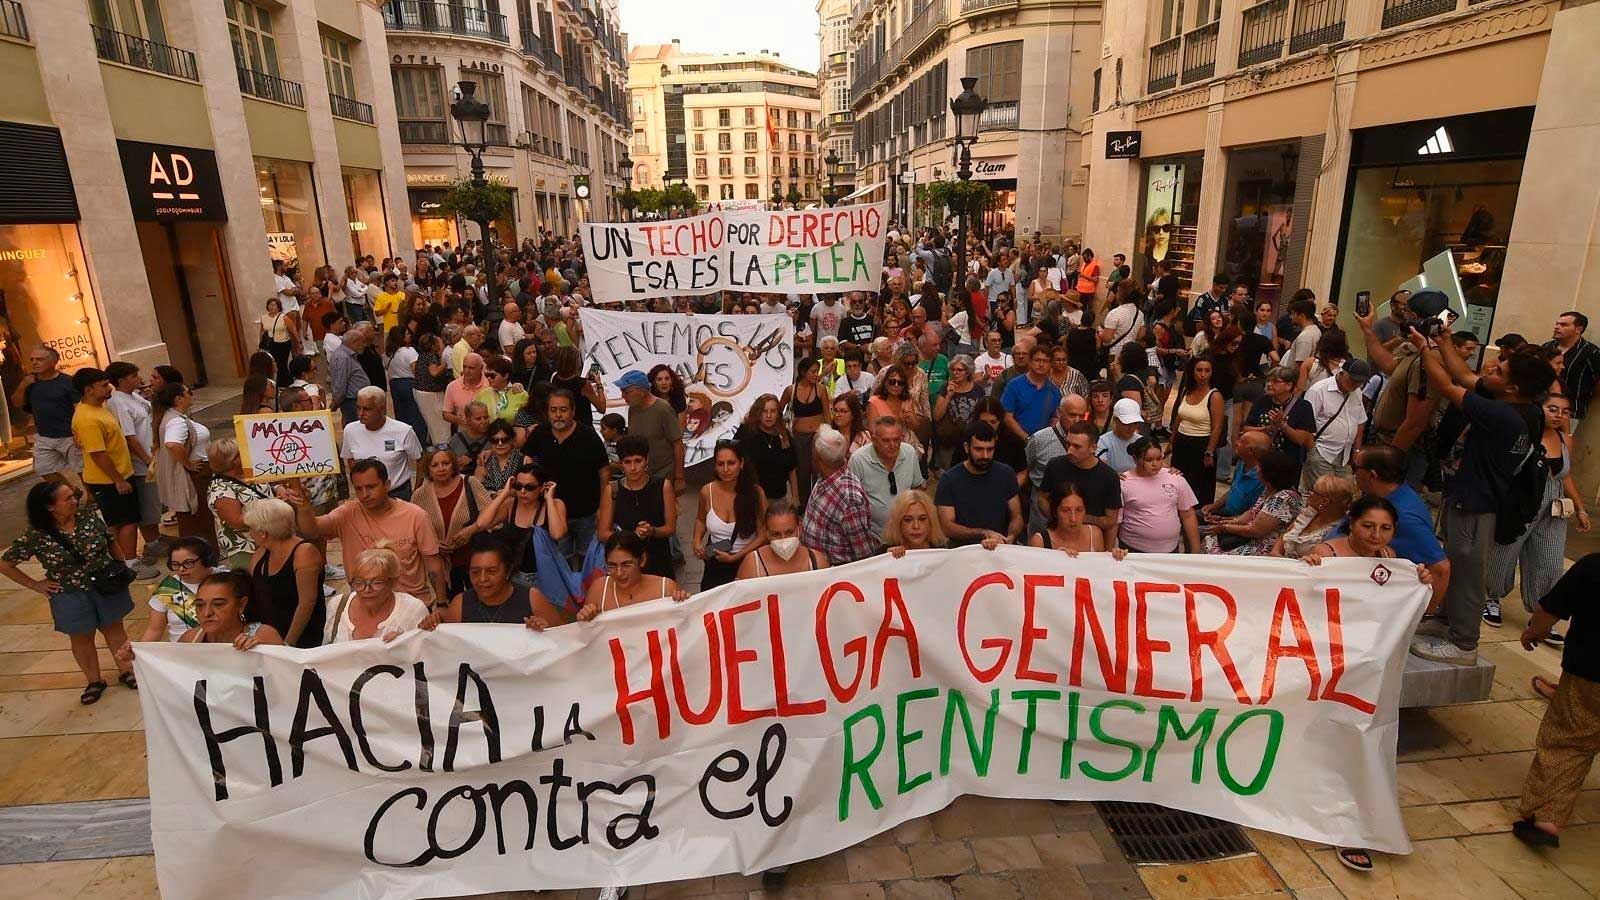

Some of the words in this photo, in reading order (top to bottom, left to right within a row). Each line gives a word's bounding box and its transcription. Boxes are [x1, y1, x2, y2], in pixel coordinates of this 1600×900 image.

[1111, 135, 1138, 152] Ray-Ban
[150, 151, 194, 186] AD
[975, 160, 1006, 172] Etam
[590, 225, 634, 261] UN
[639, 216, 724, 257] TECHO
[727, 223, 760, 246] POR
[768, 207, 880, 248] DERECHO
[627, 259, 679, 294] ESA
[691, 254, 719, 289] ES
[729, 250, 768, 286] LA
[774, 242, 871, 285] PELEA
[251, 419, 325, 439] MÁLAGA
[295, 459, 334, 474] AMOS
[193, 662, 501, 802] HACIA
[531, 702, 596, 752] LA
[608, 577, 922, 746] HUELGA
[957, 571, 1377, 715] GENERAL
[363, 758, 661, 868] contra
[699, 723, 793, 828] el
[838, 688, 1285, 823] RENTISMO
